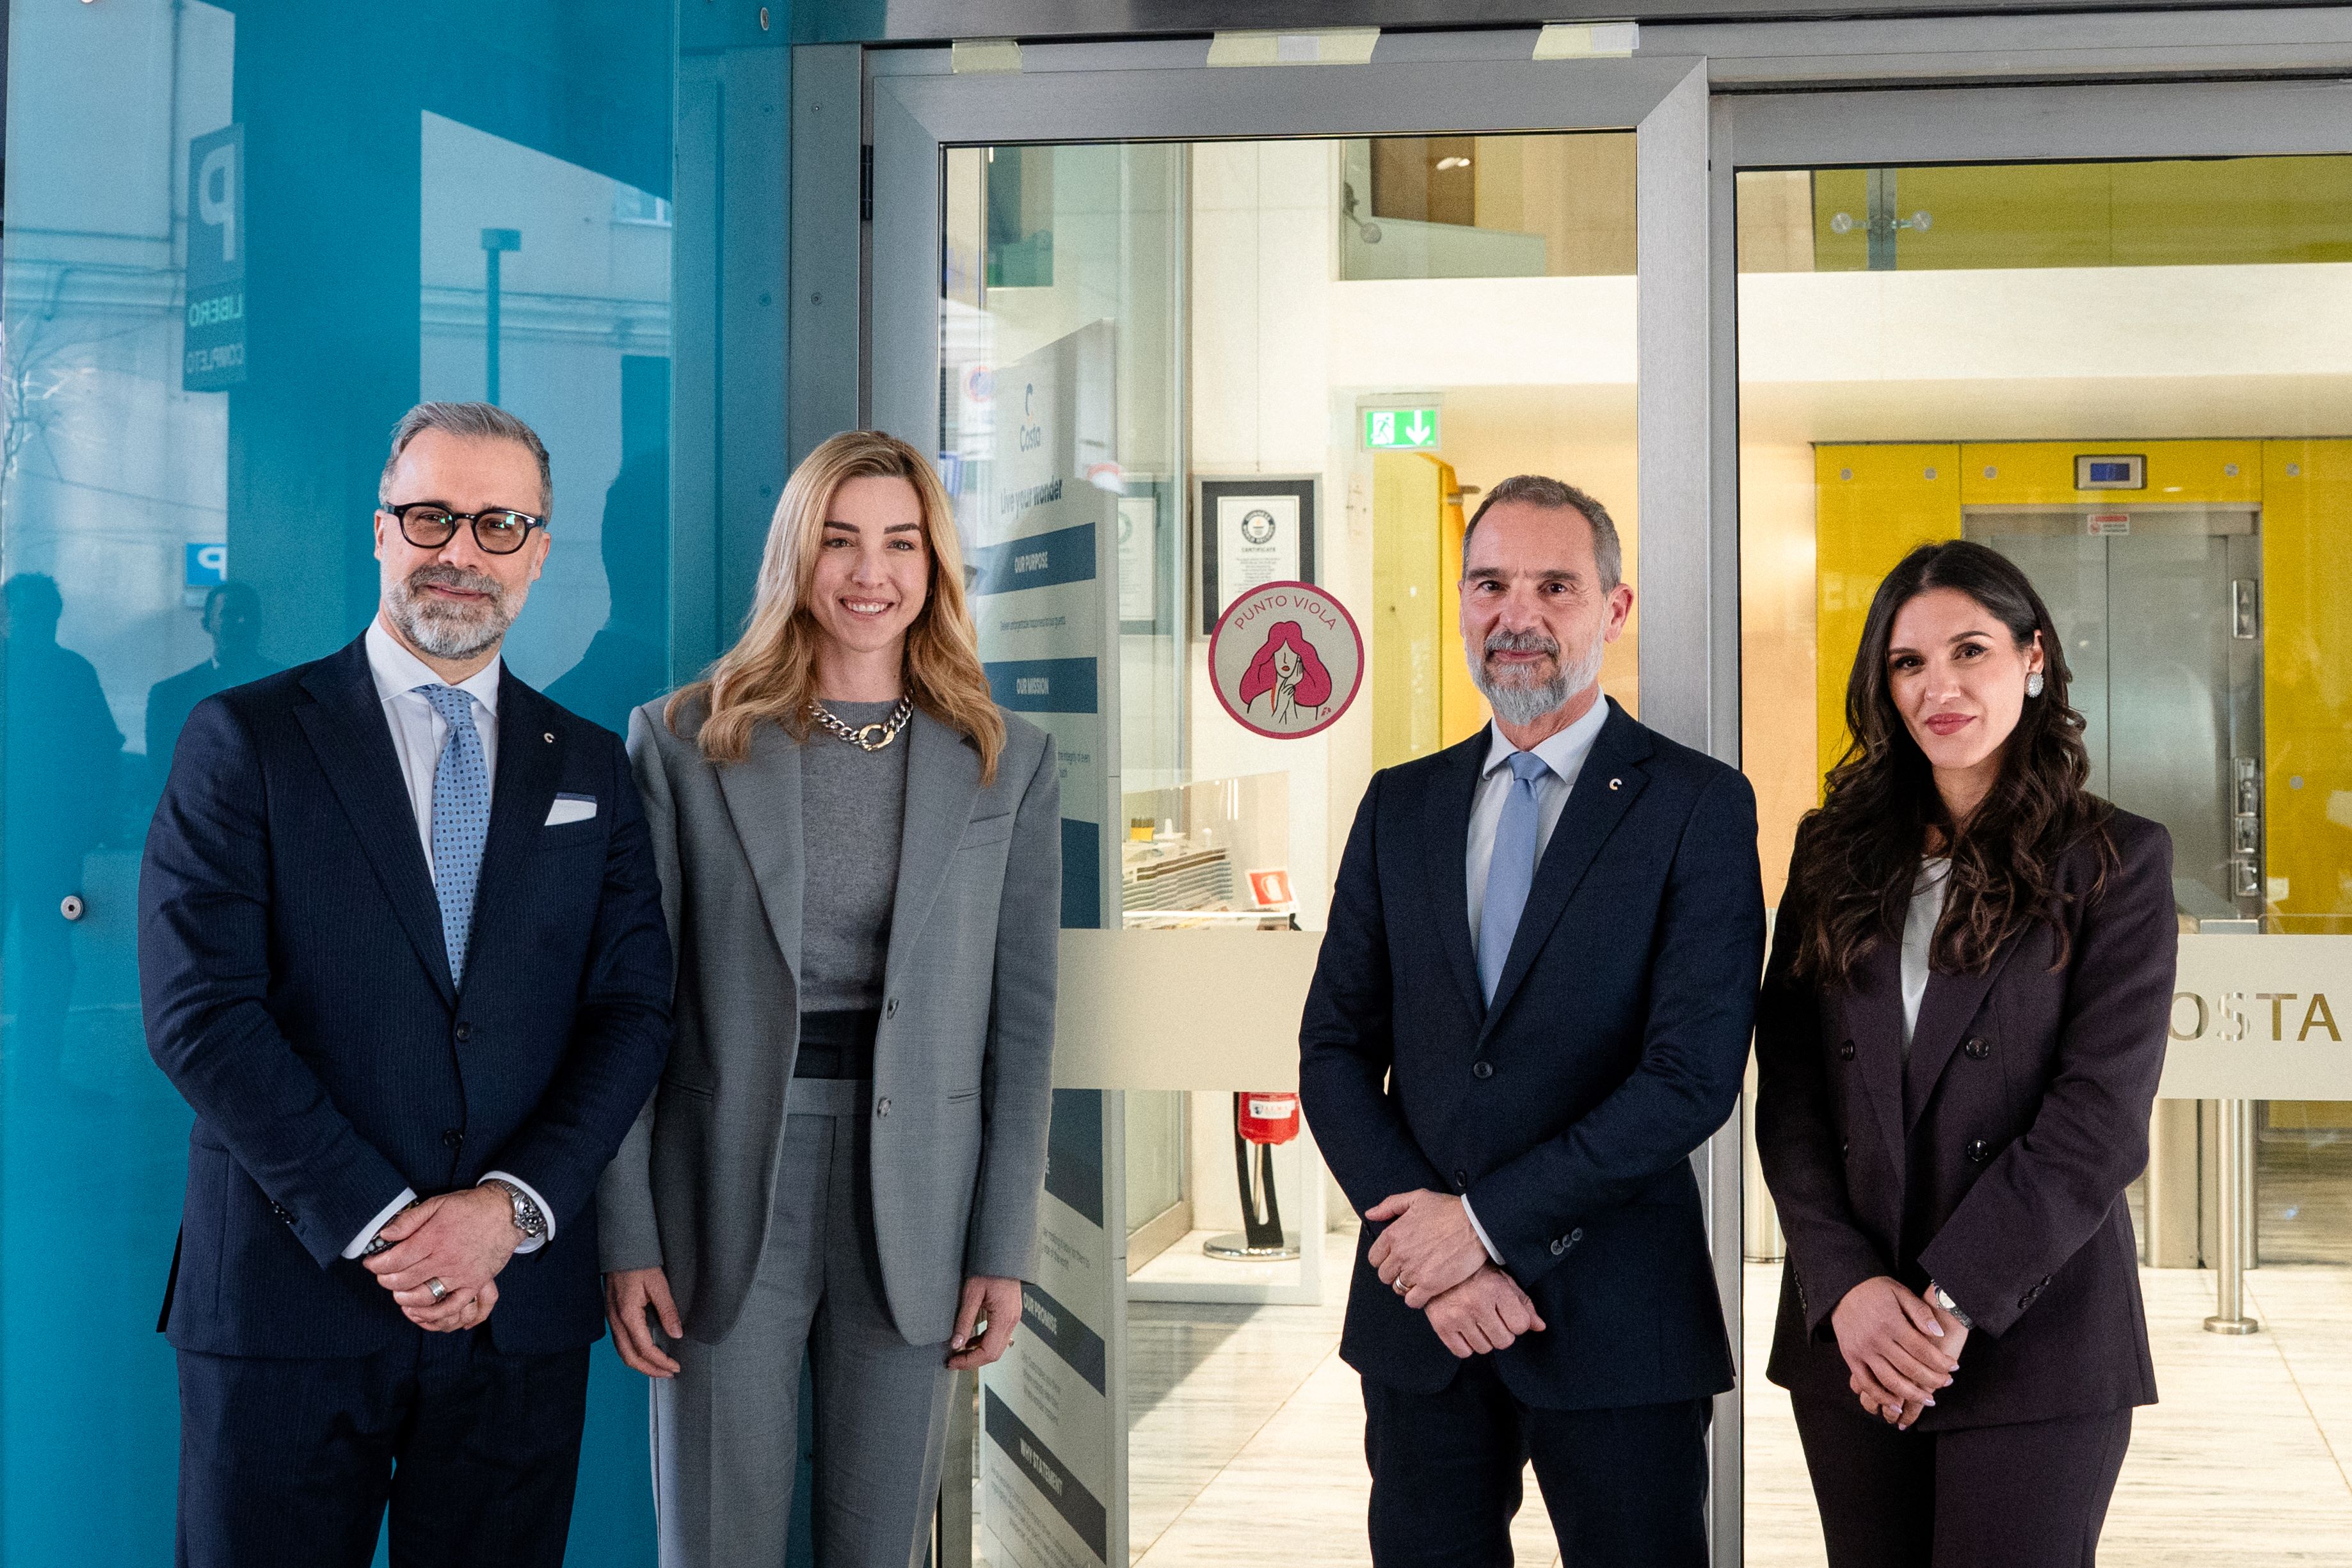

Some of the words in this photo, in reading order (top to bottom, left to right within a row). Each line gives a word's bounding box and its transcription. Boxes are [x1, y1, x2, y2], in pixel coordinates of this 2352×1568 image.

[1020, 424, 1041, 452] Costa
[1000, 488, 1014, 515] Live
[1015, 486, 1033, 520] your
[1034, 475, 1062, 506] wonder
[1014, 555, 1025, 573] OUR
[1025, 551, 1048, 572] PURPOSE
[1234, 595, 1288, 630] PUNTO
[1293, 595, 1336, 630] VIOLA
[1016, 678, 1027, 695] OUR
[1027, 677, 1049, 695] MISSION
[2168, 991, 2342, 1042] OSTA
[1020, 1437, 1032, 1464] WHY
[1032, 1450, 1062, 1497] STATEMENT
